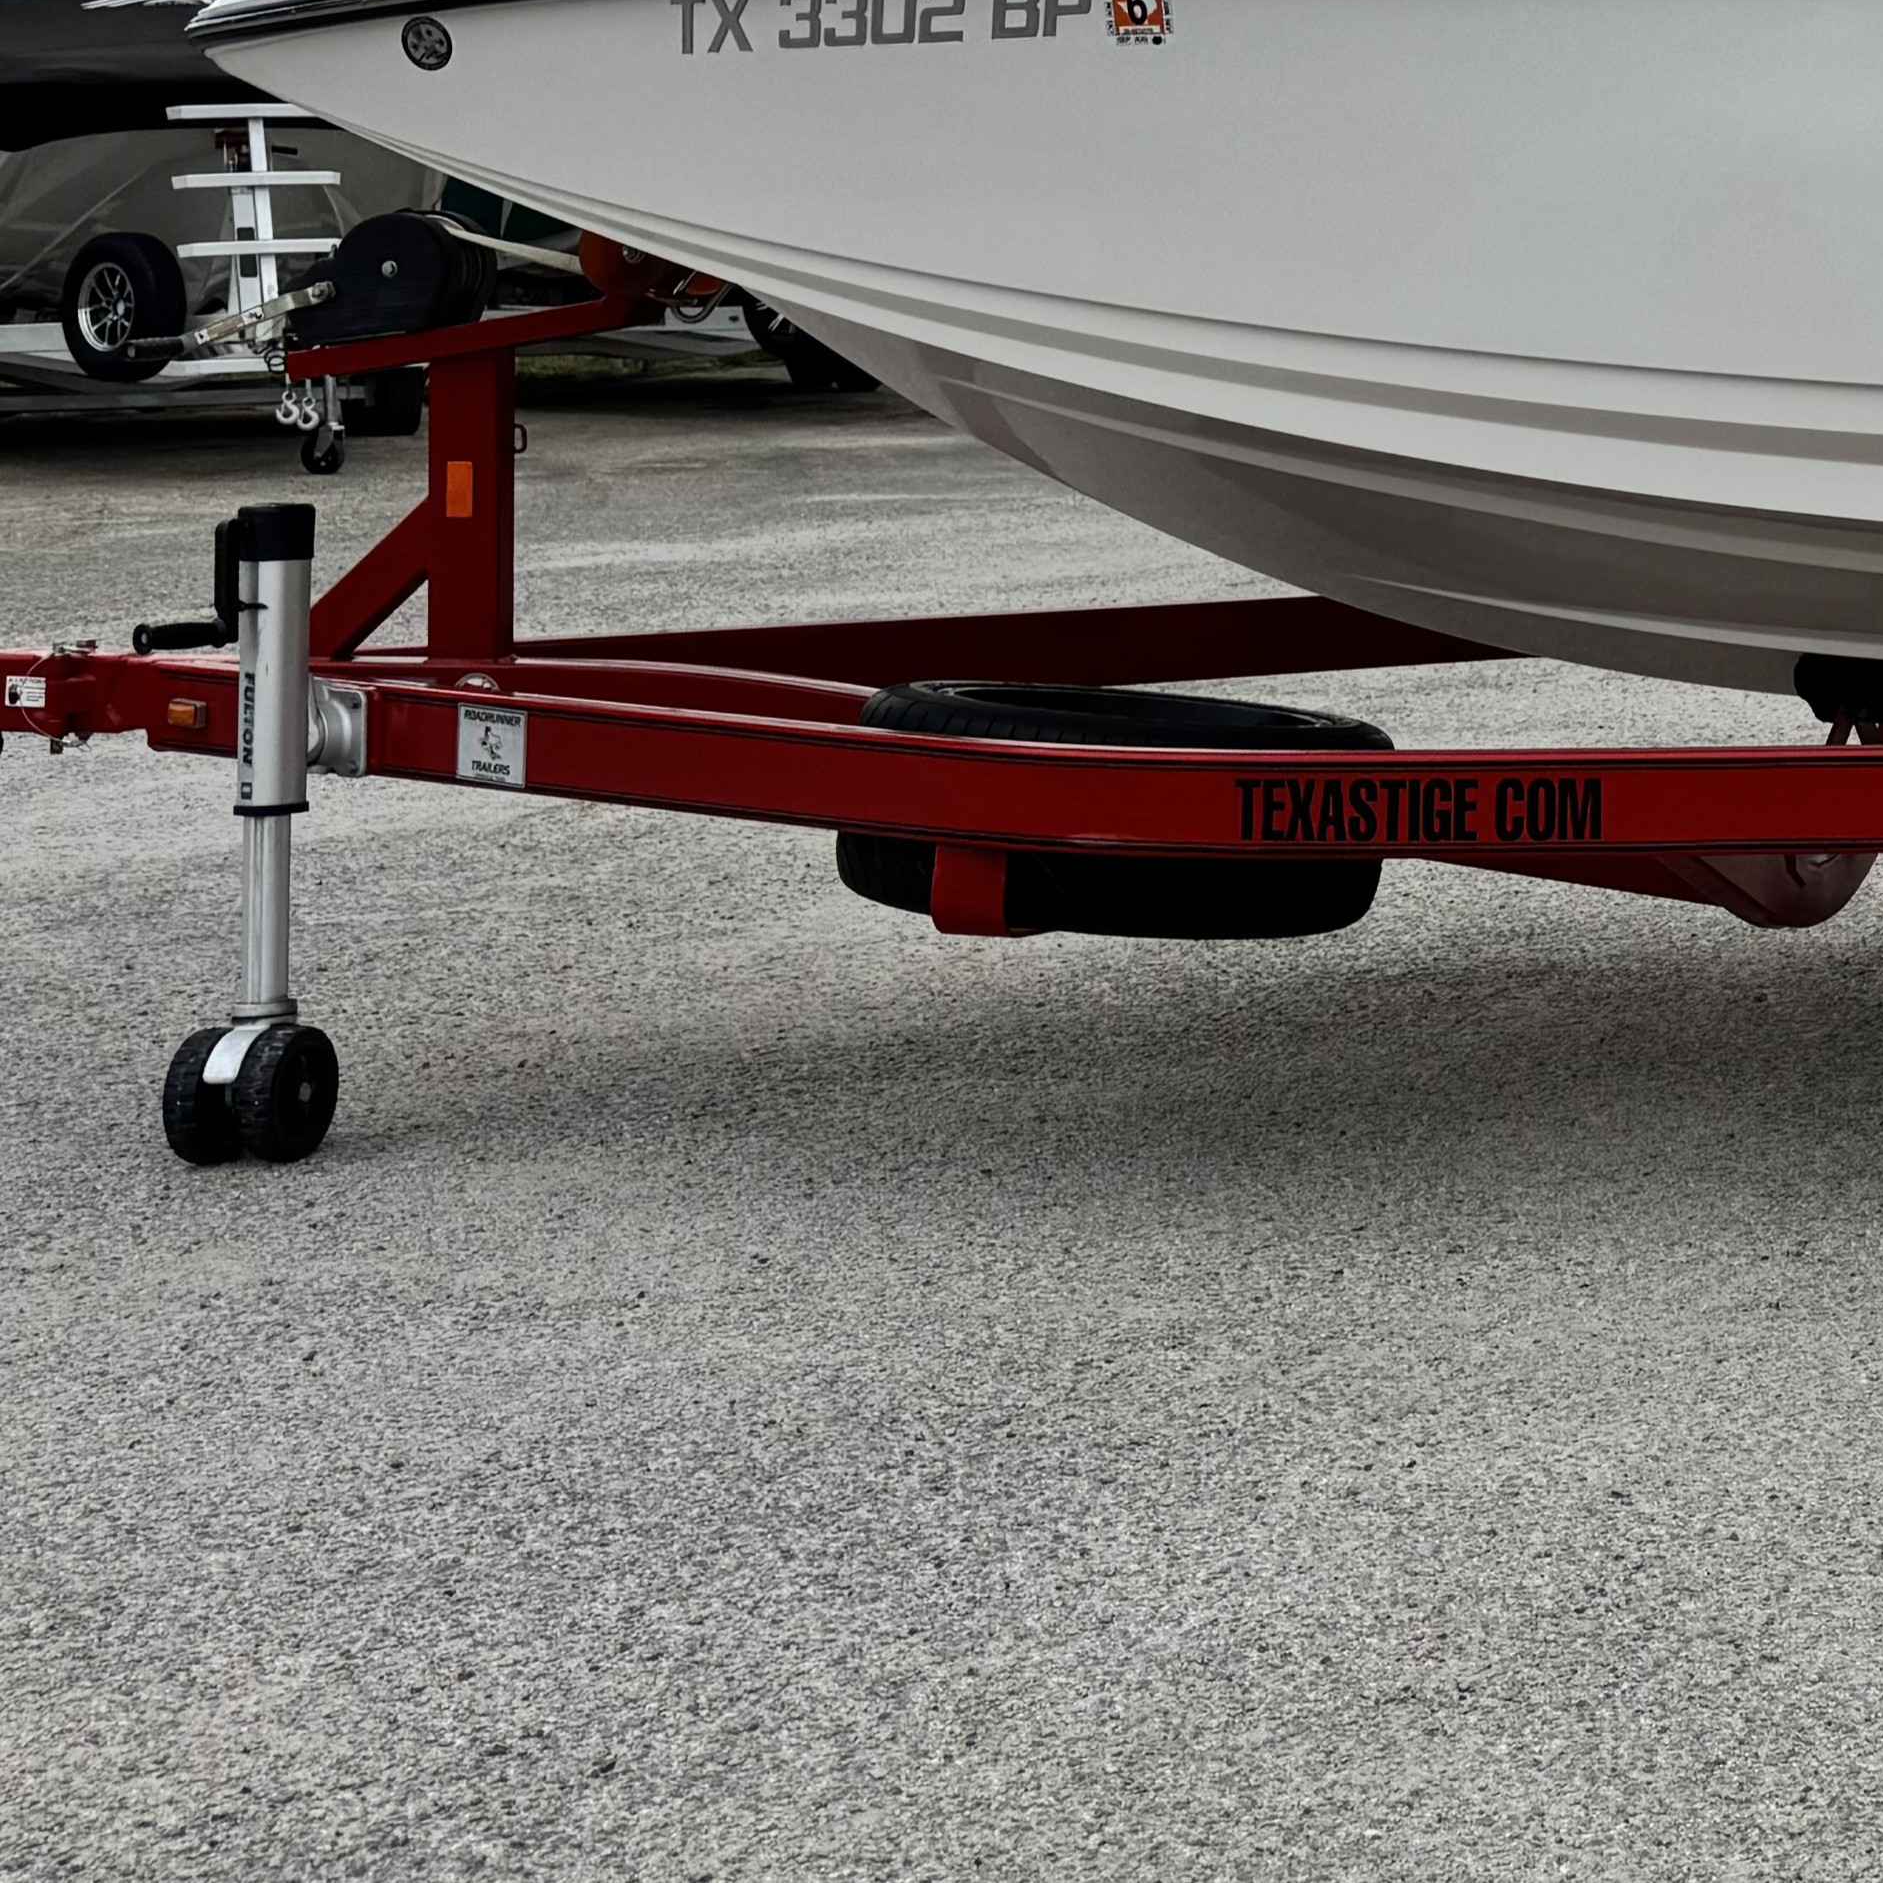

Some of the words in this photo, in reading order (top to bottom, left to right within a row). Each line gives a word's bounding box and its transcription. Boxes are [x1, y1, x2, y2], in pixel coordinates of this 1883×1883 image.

[244, 672, 256, 765] FULTON
[471, 760, 511, 776] TRAILERS
[1234, 778, 1478, 842] TEXASTIGE
[1495, 778, 1603, 842] COM
